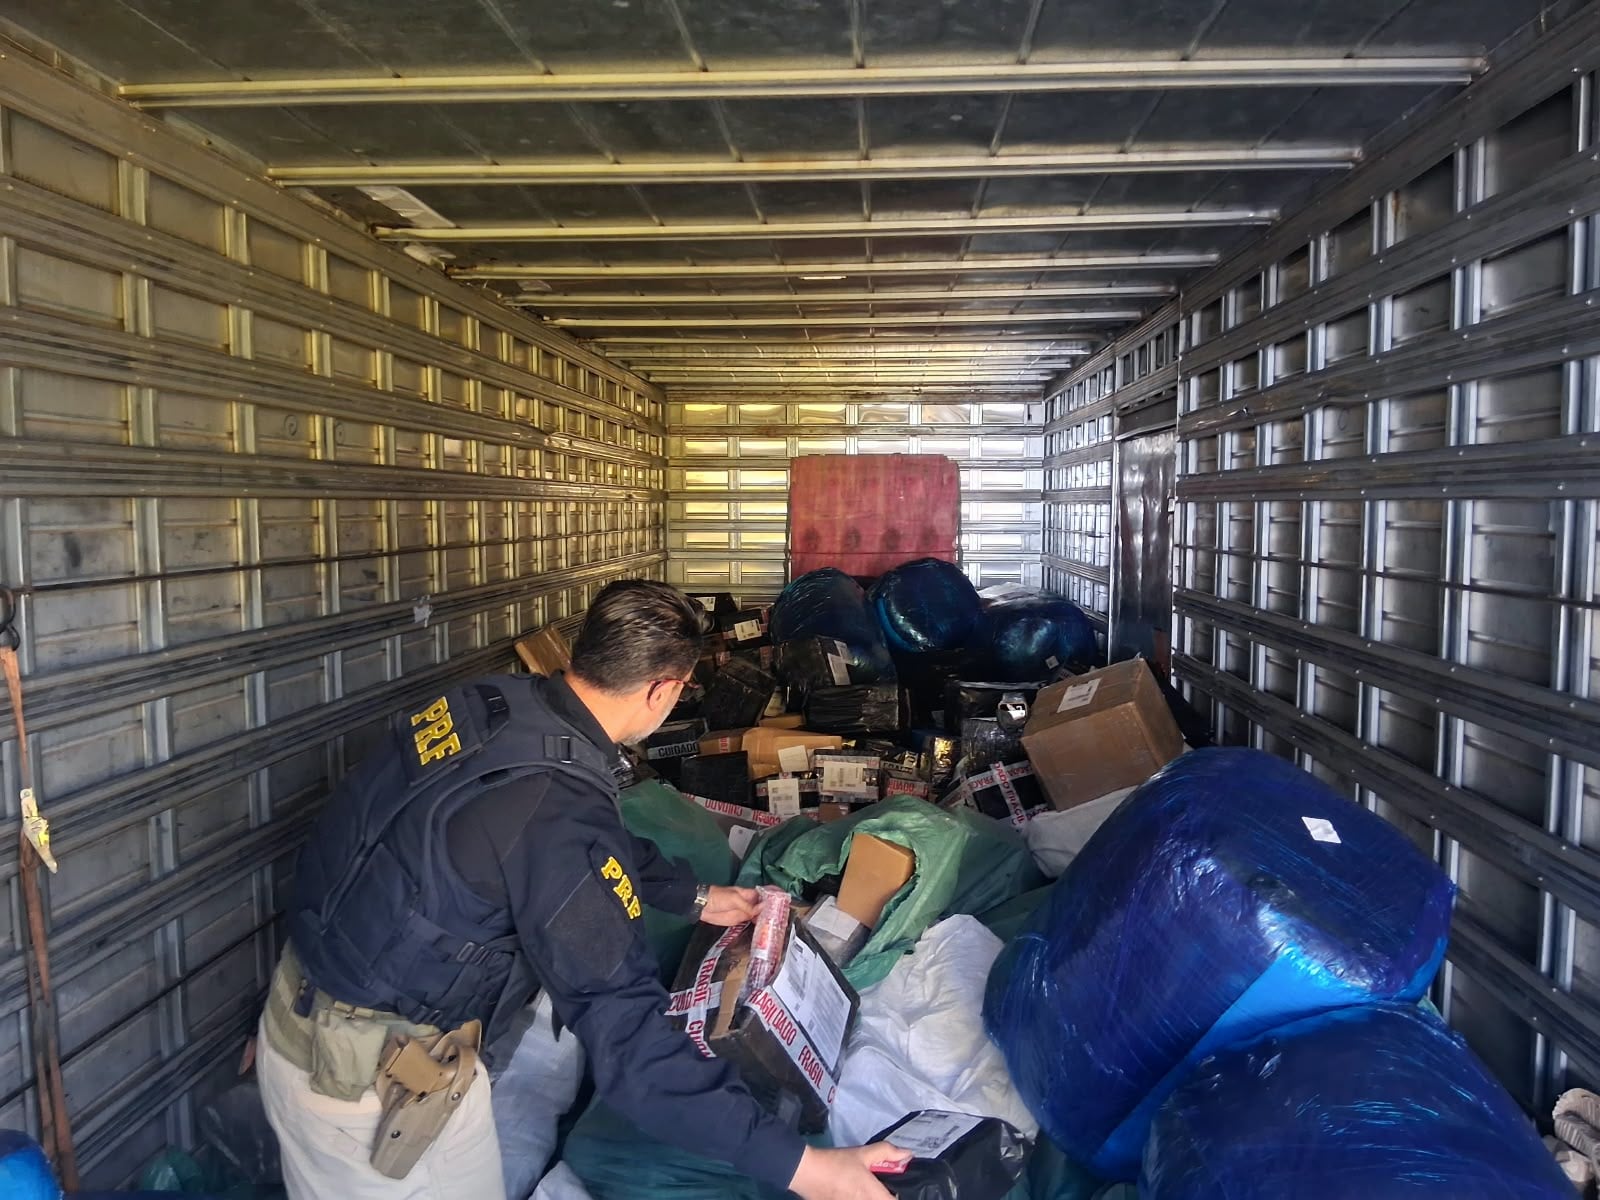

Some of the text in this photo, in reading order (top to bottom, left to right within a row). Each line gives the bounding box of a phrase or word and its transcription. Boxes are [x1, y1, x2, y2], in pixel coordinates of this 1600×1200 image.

[411, 696, 461, 766] PRF
[601, 856, 641, 919] PRF
[694, 957, 717, 1006] FRAGIL
[798, 1045, 824, 1090] FRAGIL
